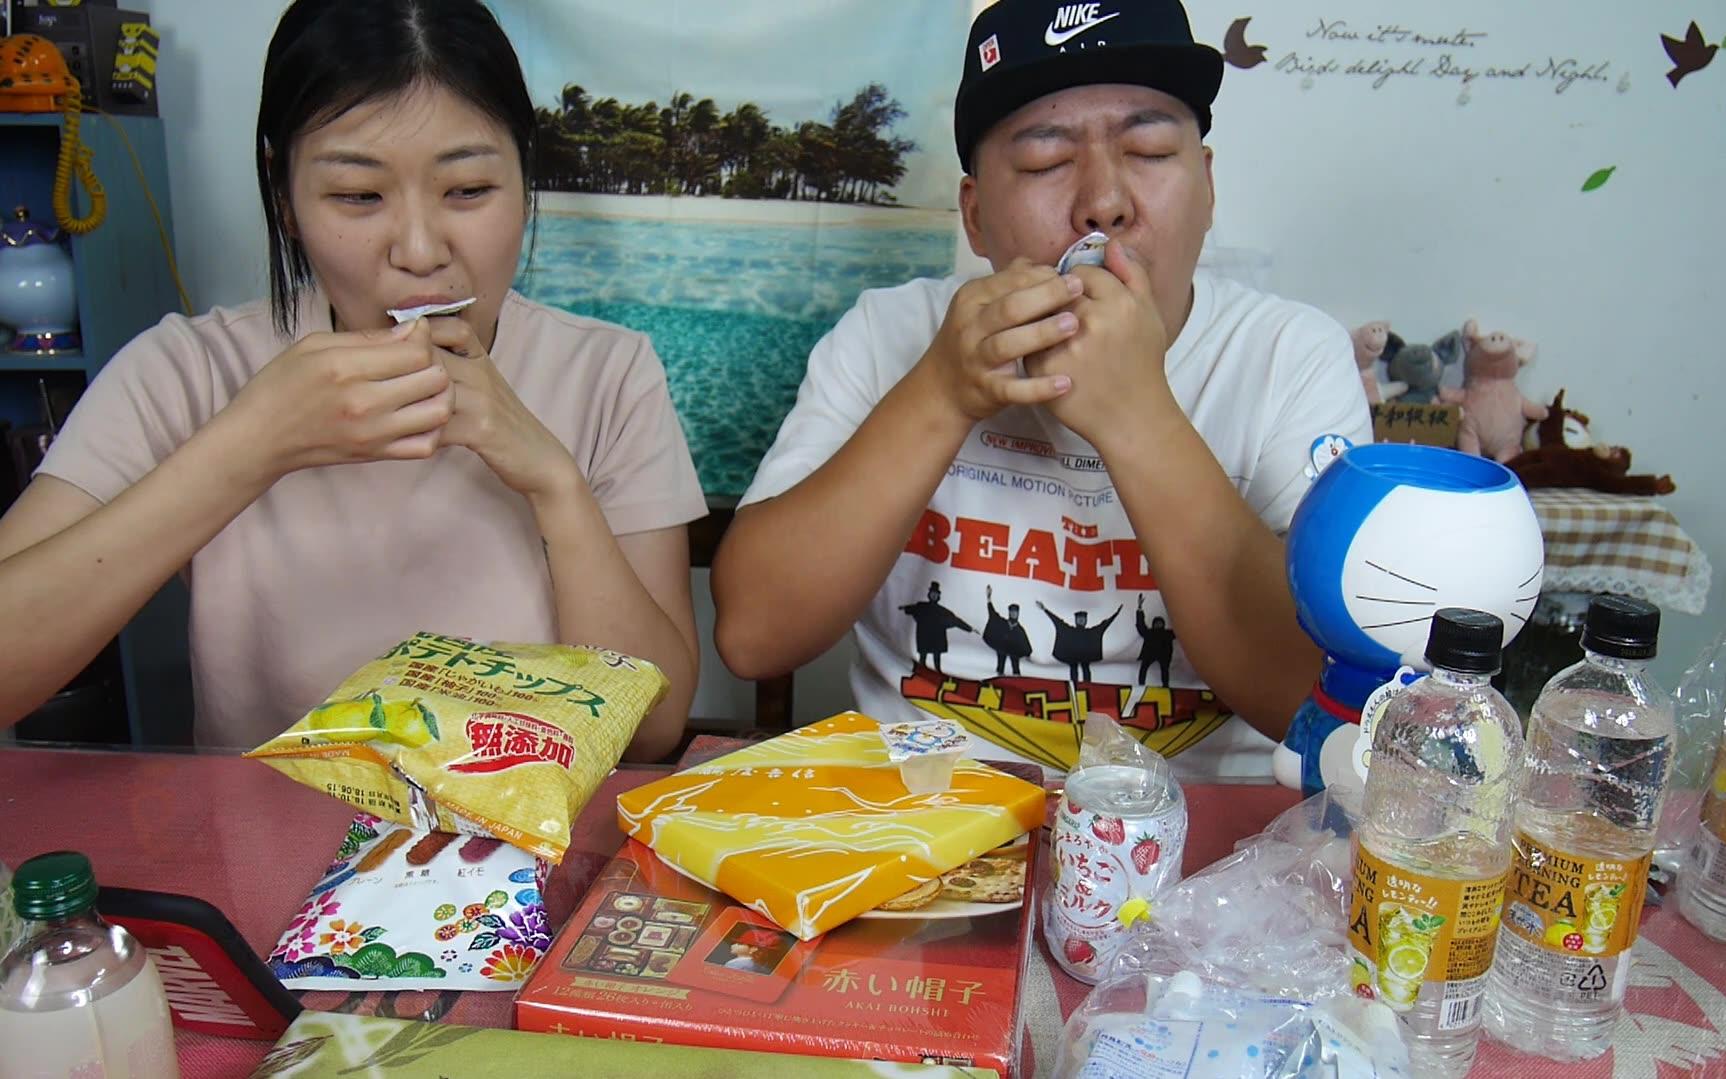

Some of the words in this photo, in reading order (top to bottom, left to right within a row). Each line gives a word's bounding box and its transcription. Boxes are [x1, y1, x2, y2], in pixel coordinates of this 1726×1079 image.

[1053, 3, 1103, 29] NIKE
[1345, 58, 1424, 89] delight
[1485, 63, 1531, 78] and
[986, 434, 1008, 447] NEW
[947, 463, 1006, 487] ORIGINAL
[1011, 475, 1066, 498] MOTION
[1074, 457, 1105, 470] DIME
[1061, 516, 1099, 539] THE
[903, 510, 1164, 592] BEATL
[384, 639, 606, 719] ポテトチップス
[470, 721, 574, 770] 無添加
[475, 815, 489, 825] IN
[489, 821, 524, 840] JAPAN
[1059, 847, 1117, 882] いちご
[1059, 884, 1113, 918] ミルク
[1513, 867, 1577, 919] TEA
[822, 968, 988, 1006] 赤い帽子
[846, 1001, 881, 1012] AKAI
[888, 1005, 951, 1018] BOHSHI
